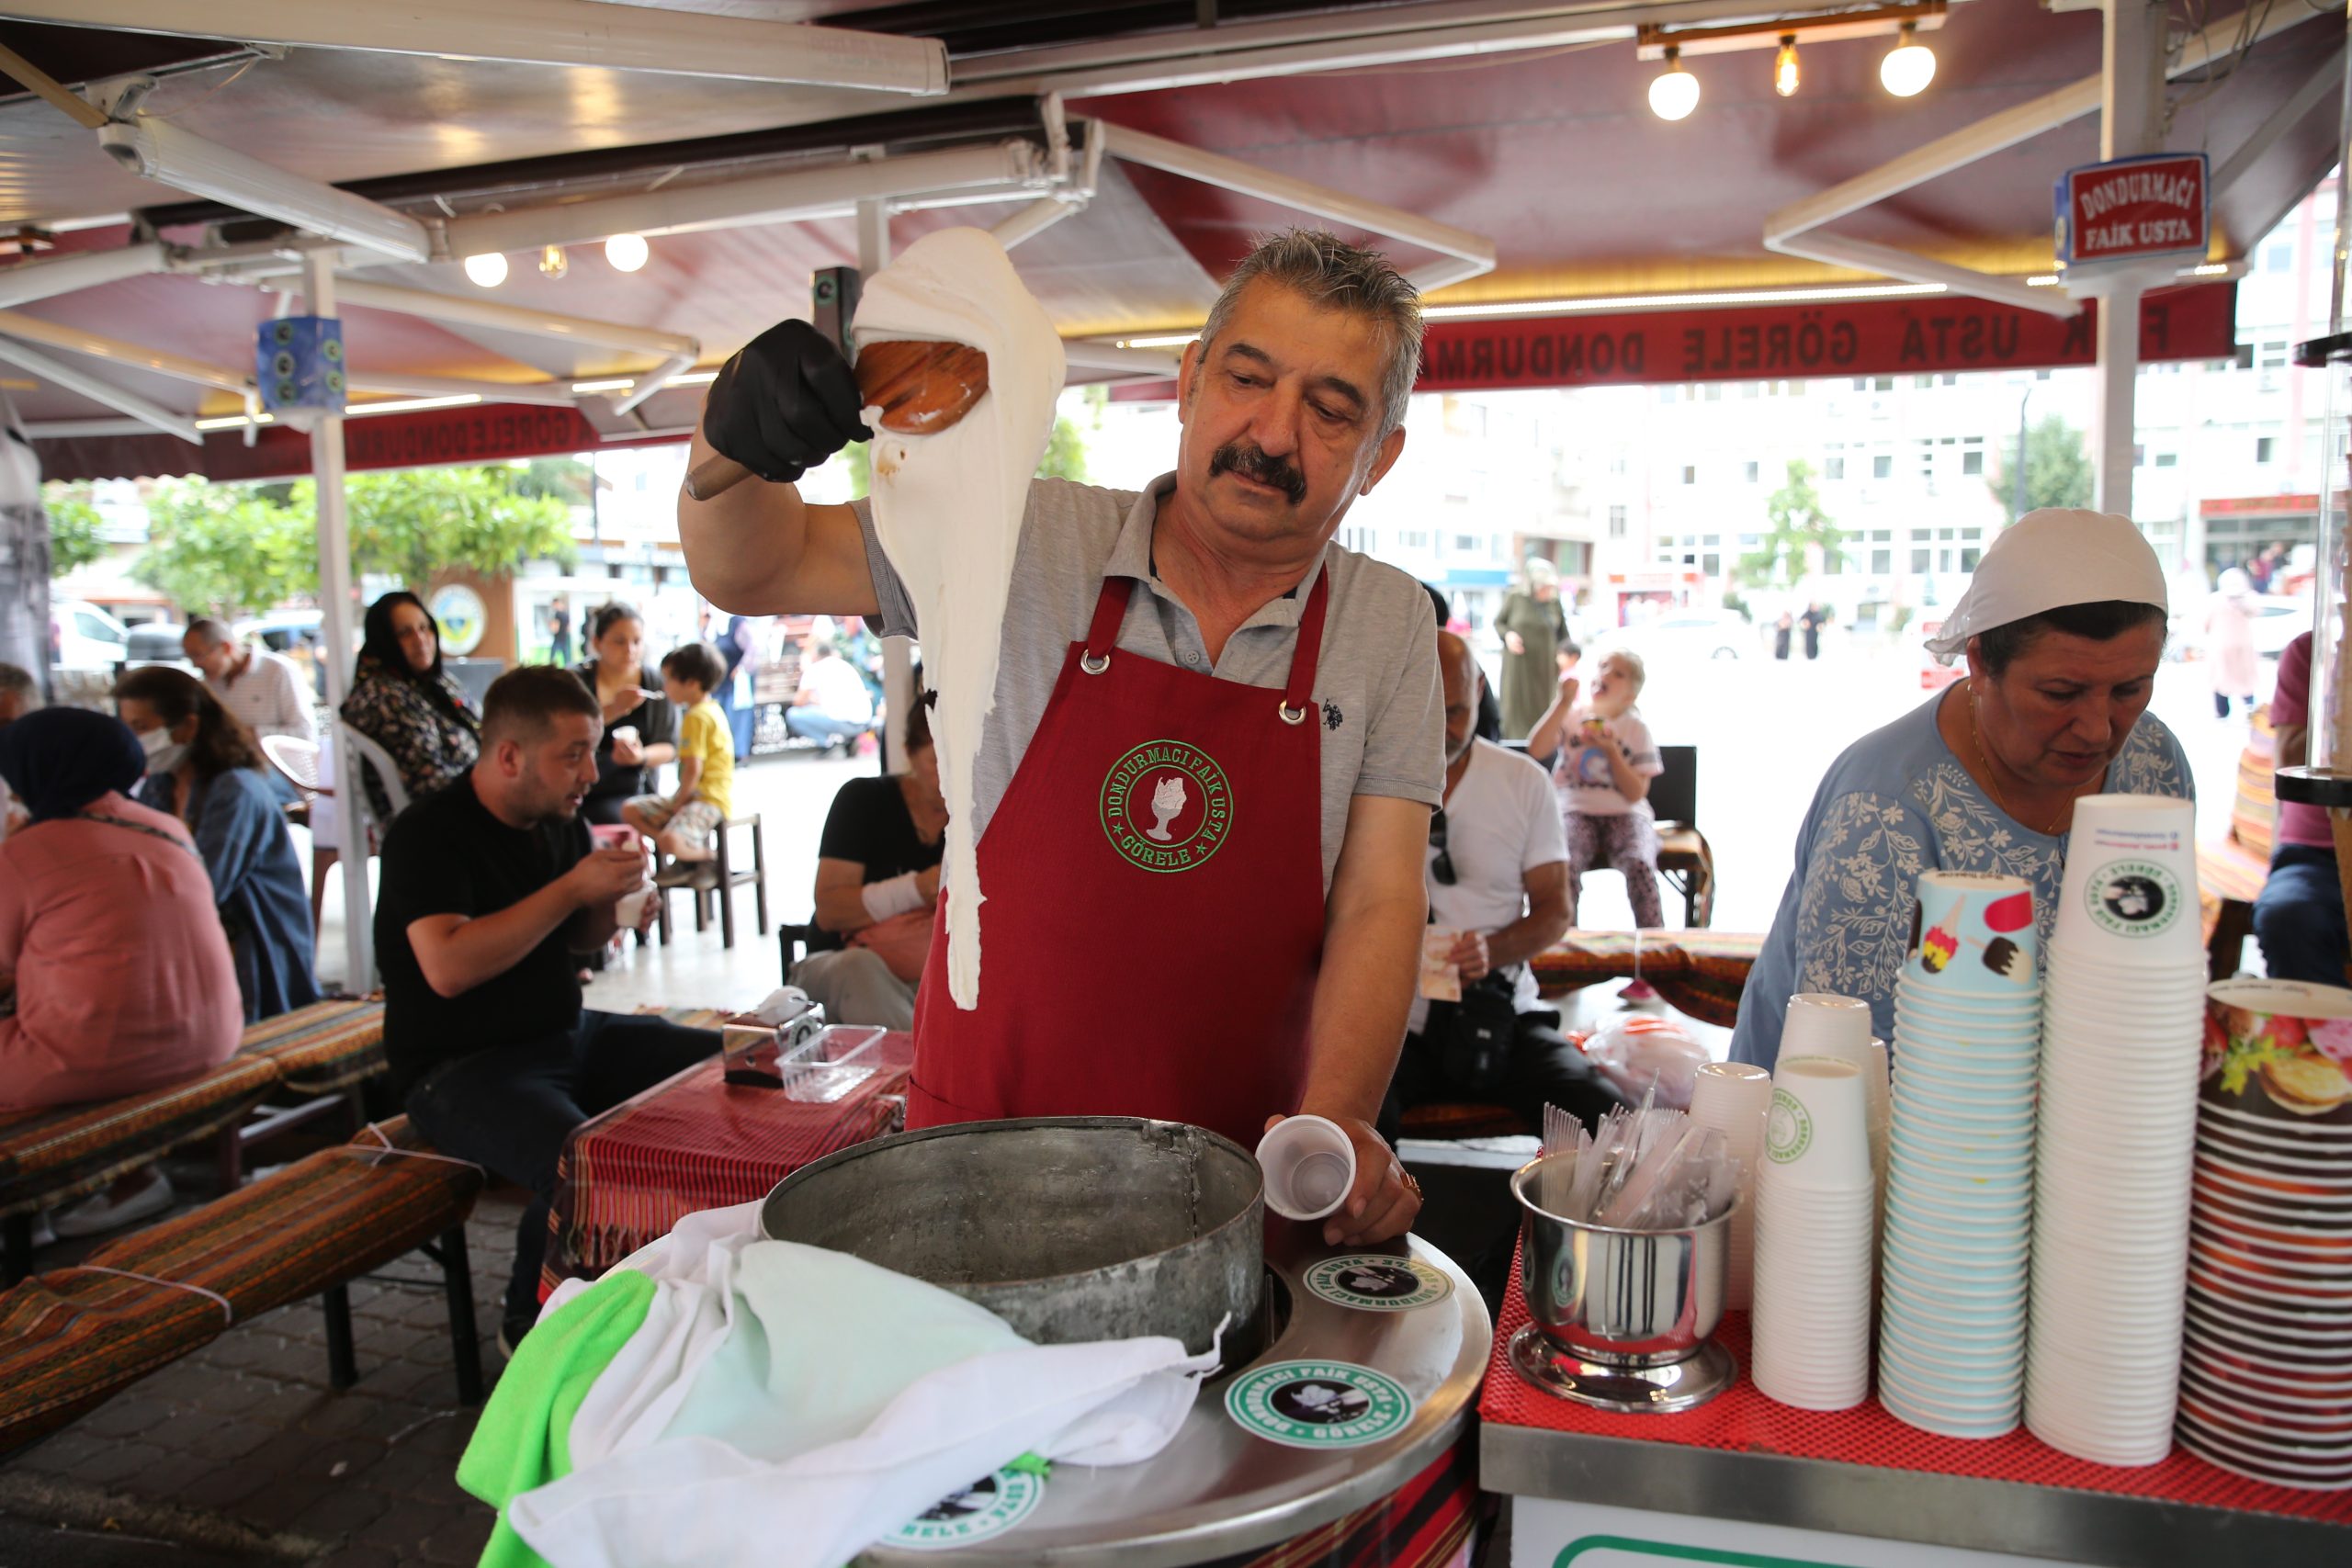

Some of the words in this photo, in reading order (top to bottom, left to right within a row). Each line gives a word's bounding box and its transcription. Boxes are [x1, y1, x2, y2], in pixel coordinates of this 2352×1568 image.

[2079, 172, 2196, 220] DONDURMACI
[2085, 220, 2134, 251] FAİK
[2139, 219, 2192, 244] USTA
[1107, 747, 1191, 818] DONDURMACI
[1188, 756, 1224, 795] FAİK
[1202, 796, 1227, 841] USTA
[1120, 834, 1192, 866] GÖRELE
[1330, 1258, 1365, 1275] USTA
[1299, 1366, 1351, 1379] FAİK
[1352, 1377, 1394, 1404] USTA
[900, 1523, 971, 1538] RELE
